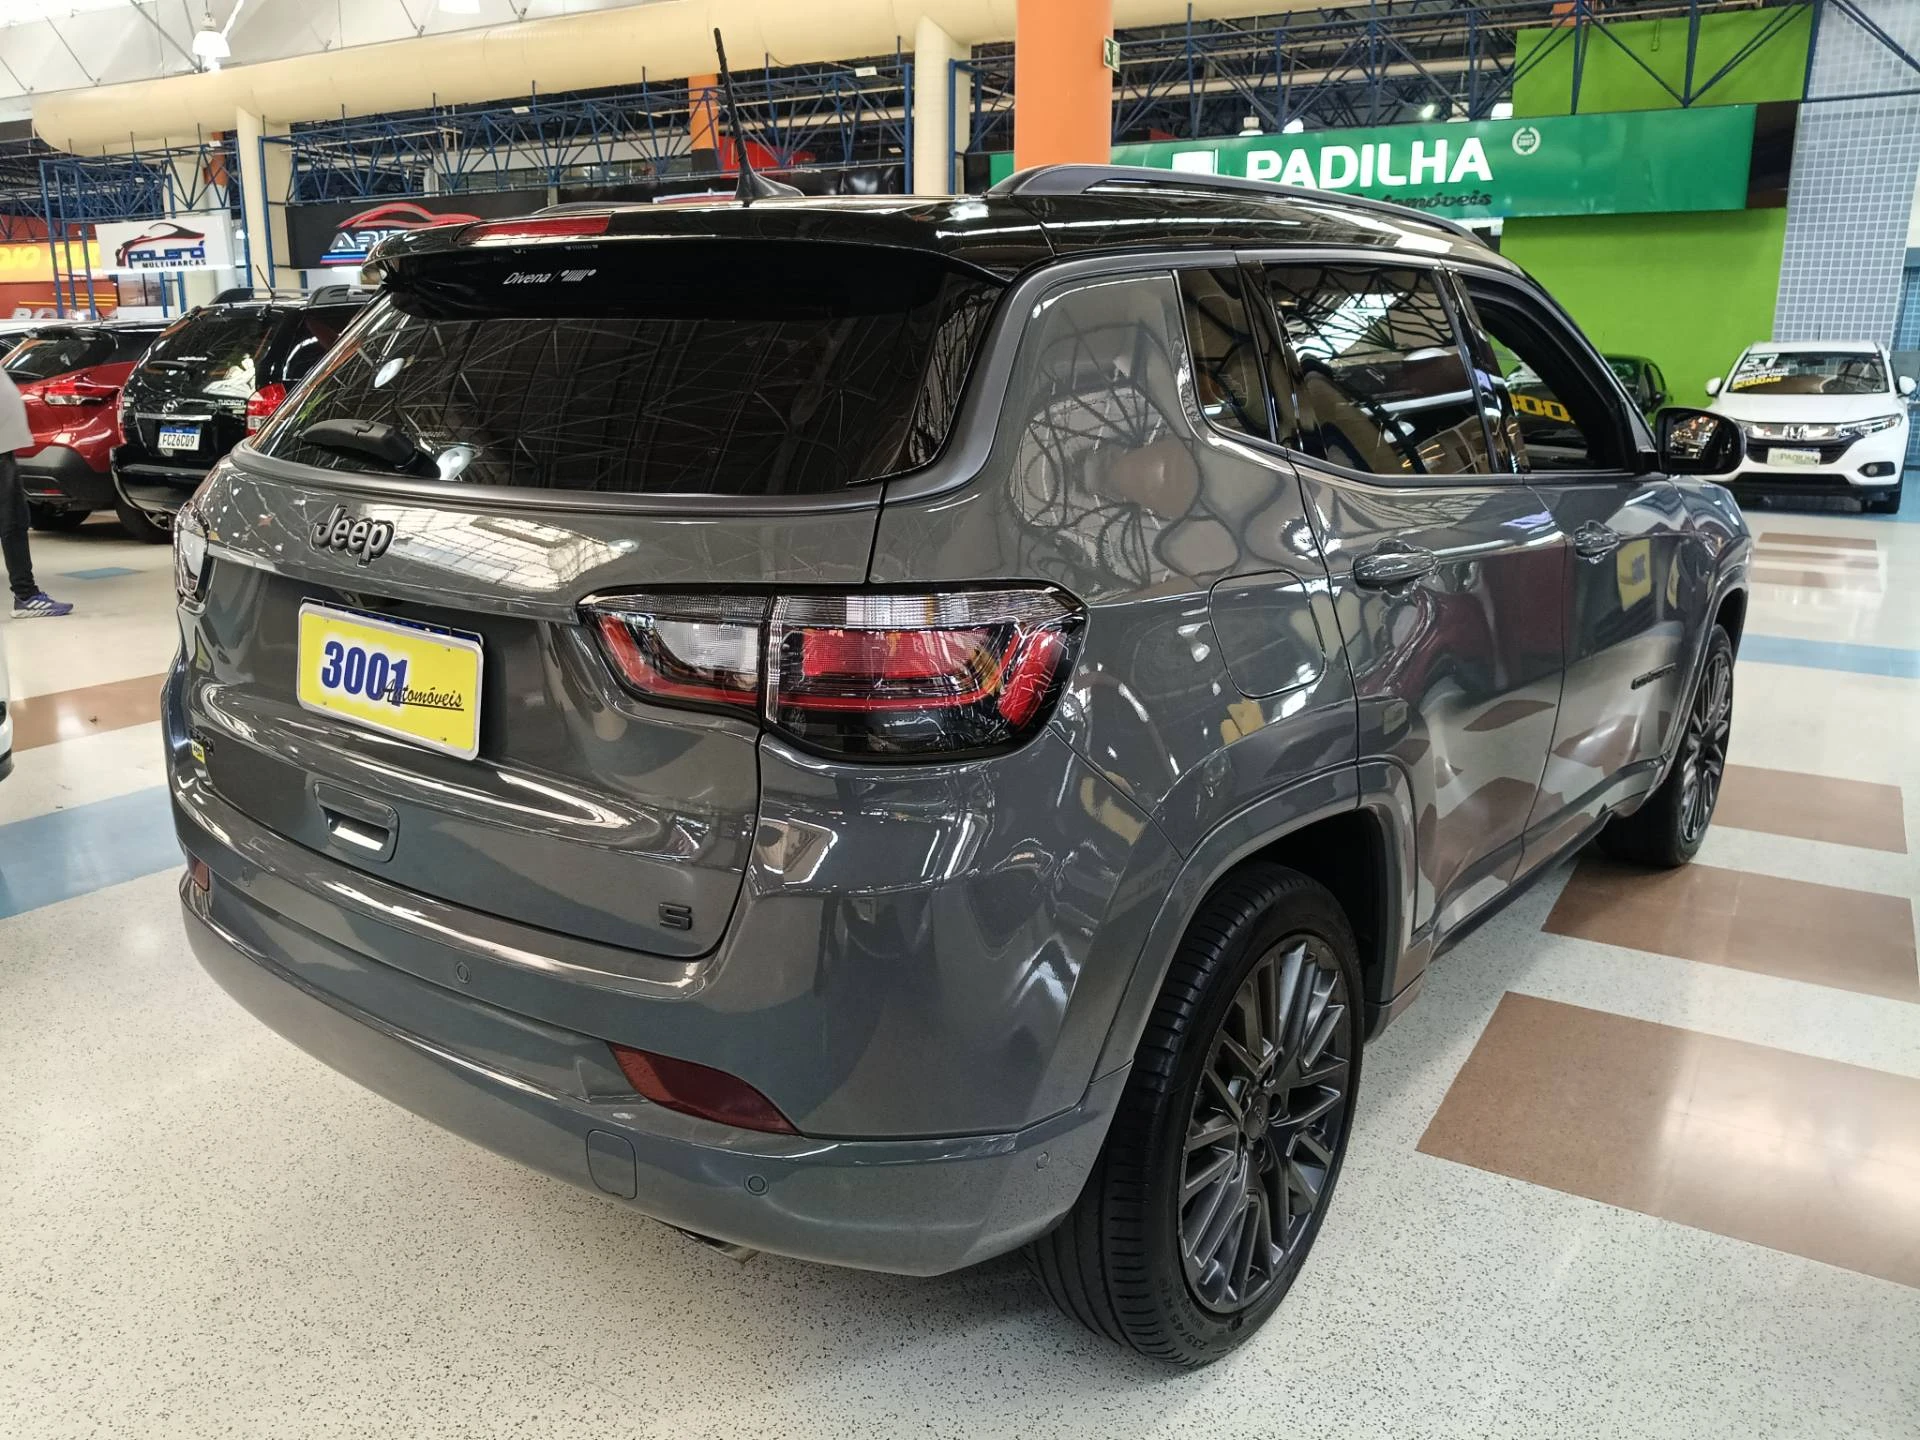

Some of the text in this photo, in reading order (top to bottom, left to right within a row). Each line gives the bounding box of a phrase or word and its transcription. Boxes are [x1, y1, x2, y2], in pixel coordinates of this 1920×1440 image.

[1246, 137, 1493, 189] PADILHA
[142, 259, 207, 268] MULTIMARCAS
[503, 272, 551, 285] Divena
[312, 504, 394, 567] Jeep
[321, 640, 408, 708] 3001
[381, 679, 464, 709] Automóveis
[659, 902, 692, 931] S
